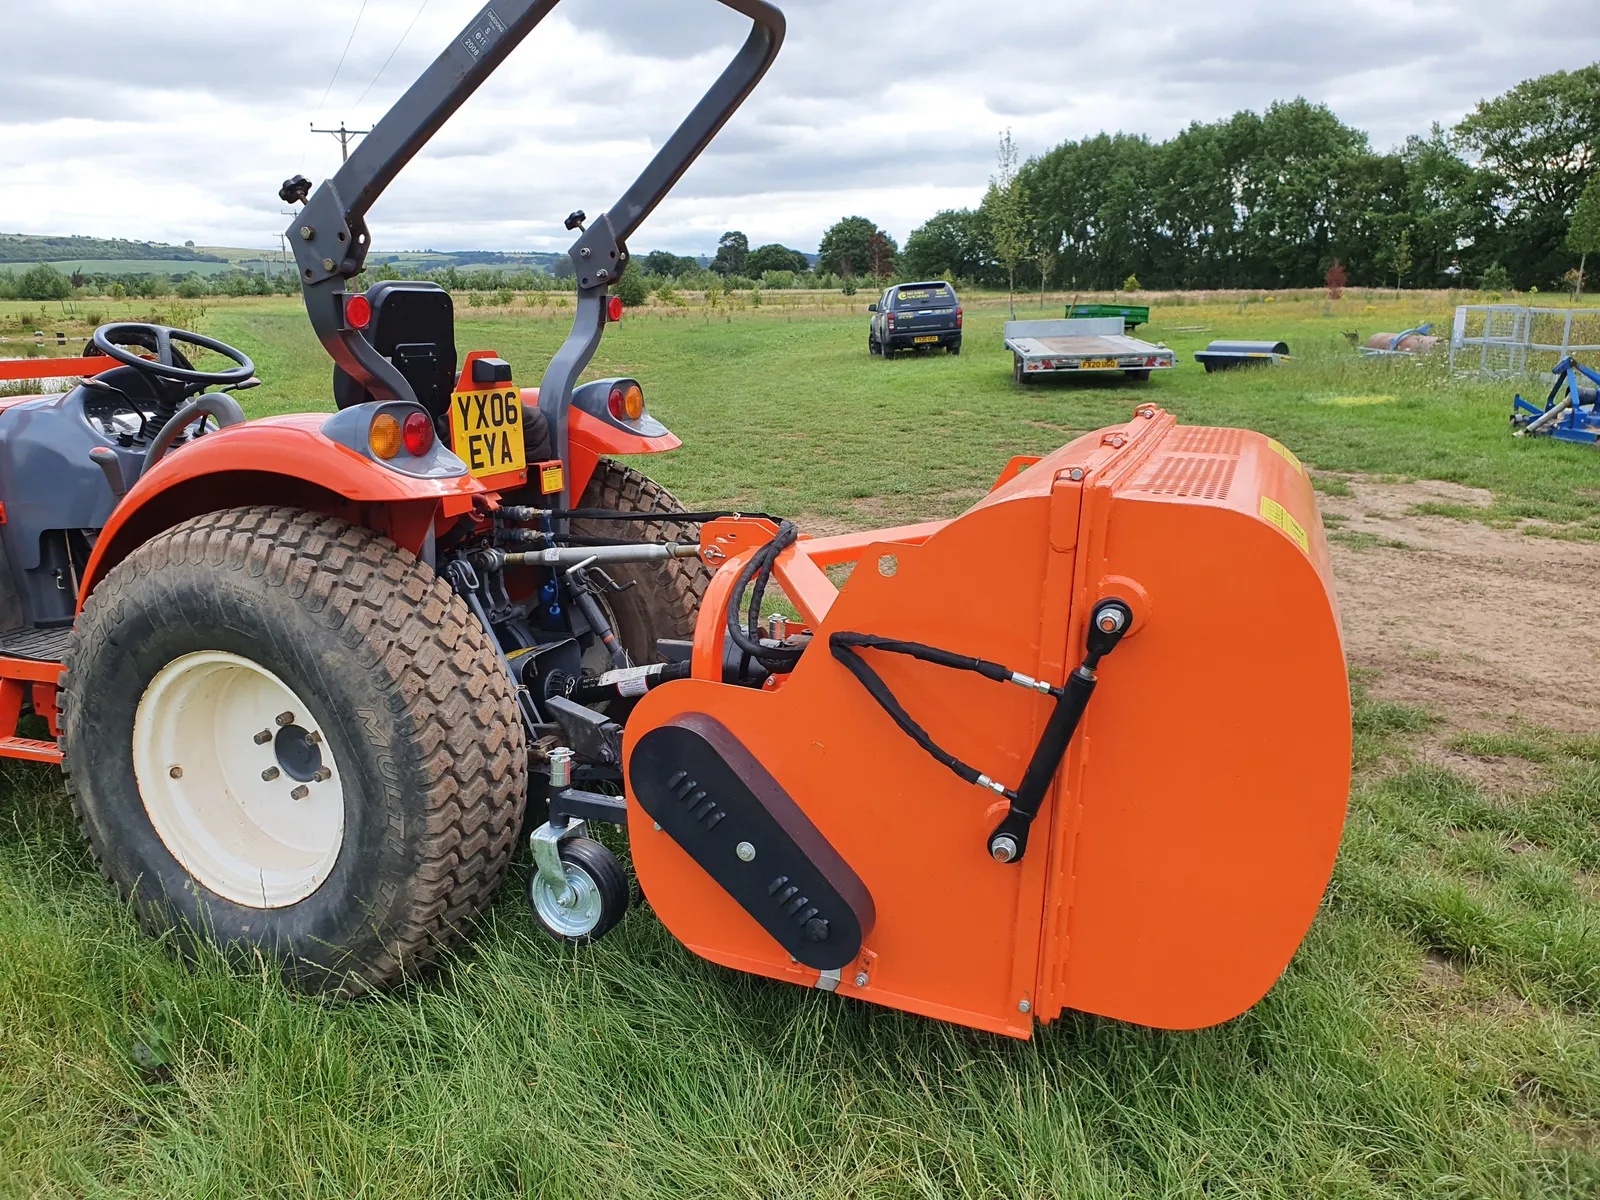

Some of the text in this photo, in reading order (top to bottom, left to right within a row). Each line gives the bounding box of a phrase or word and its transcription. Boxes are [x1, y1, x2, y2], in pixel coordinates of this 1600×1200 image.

[484, 27, 491, 35] S
[487, 11, 504, 32] DAEDONG
[465, 39, 479, 56] 2008
[475, 32, 487, 46] e11
[1101, 360, 1116, 368] UGO
[457, 391, 518, 431] YX06
[468, 431, 514, 470] EYA
[356, 707, 406, 857] MULTI
